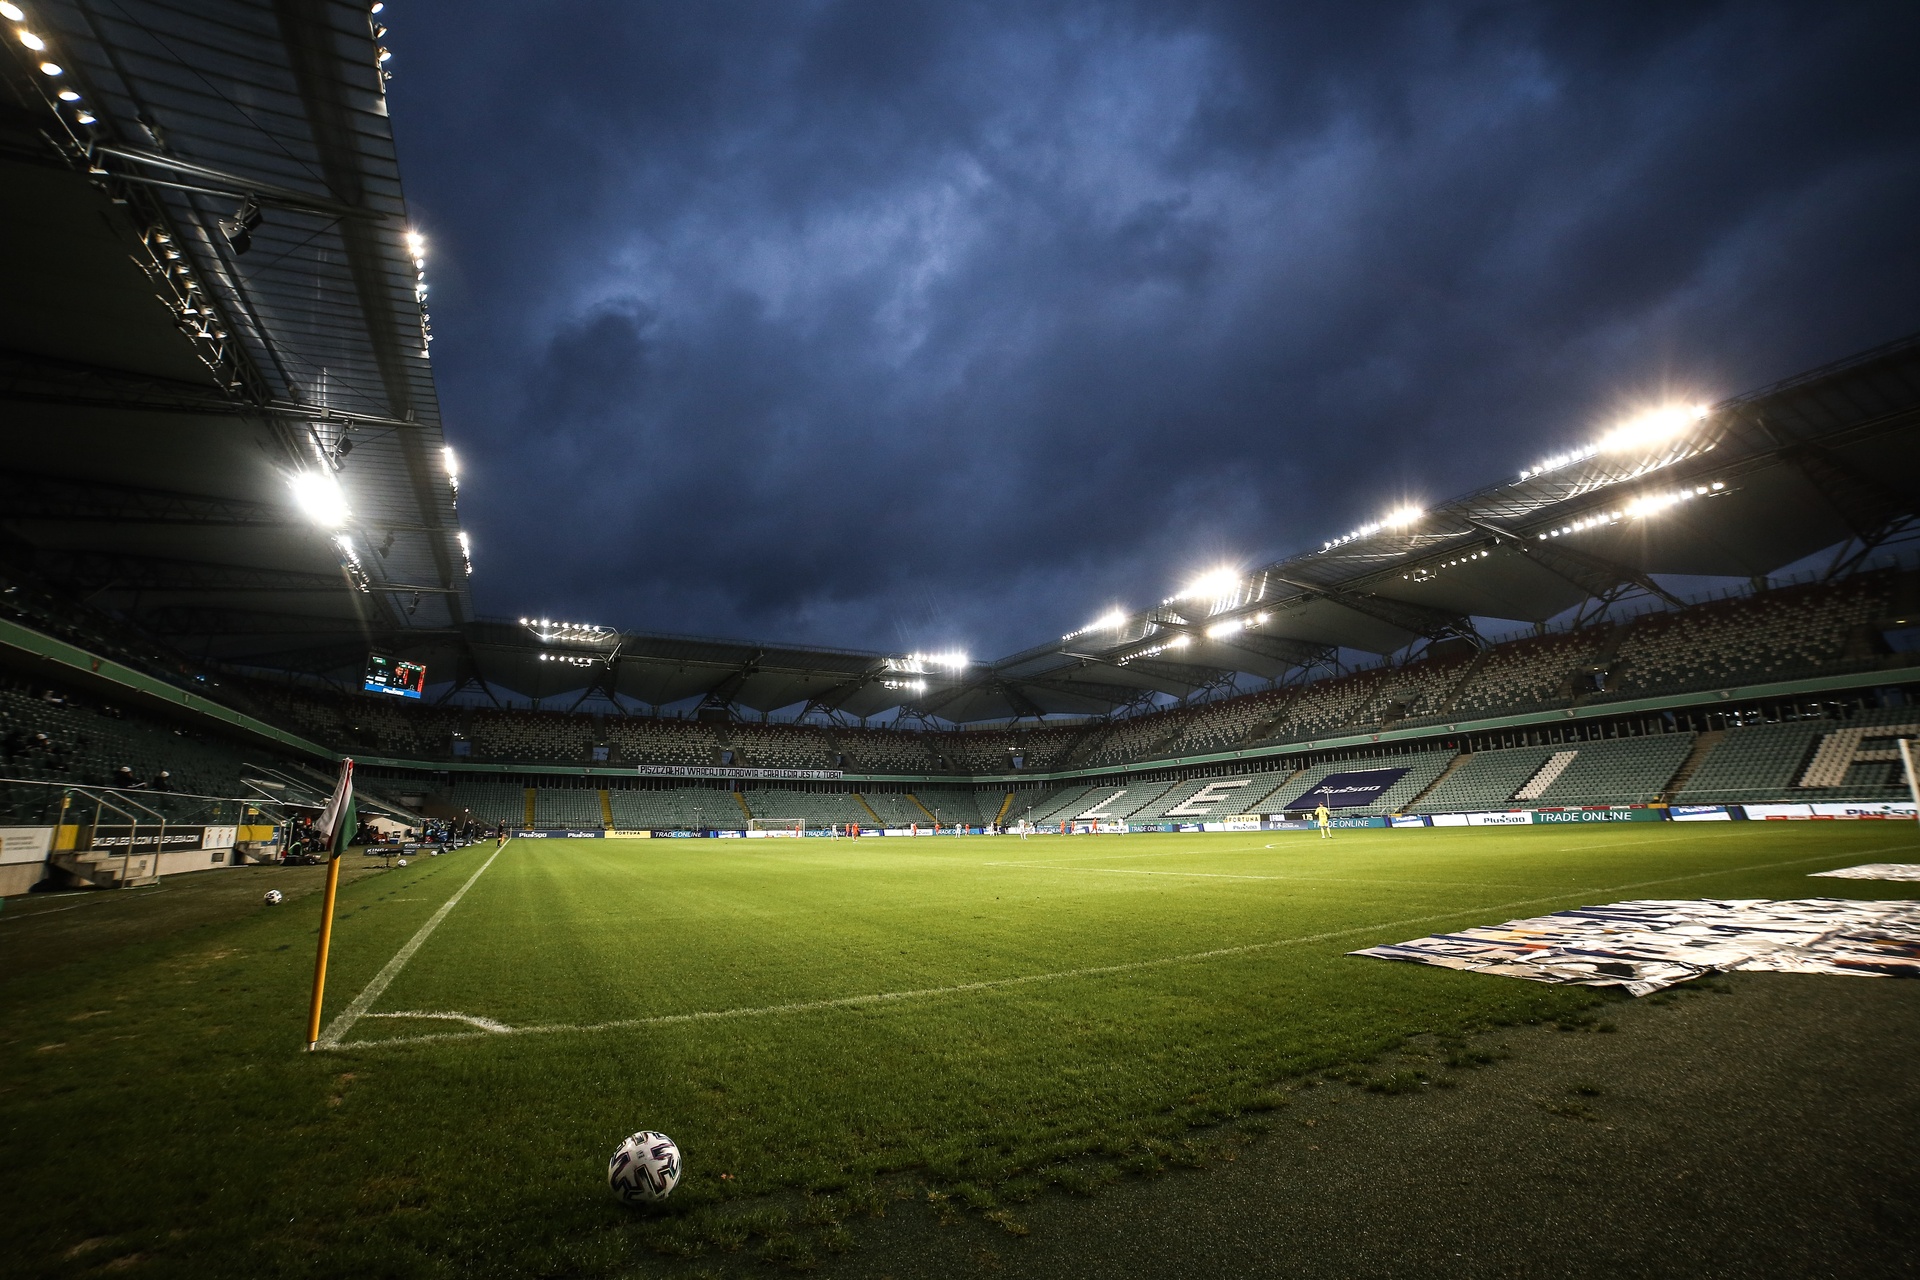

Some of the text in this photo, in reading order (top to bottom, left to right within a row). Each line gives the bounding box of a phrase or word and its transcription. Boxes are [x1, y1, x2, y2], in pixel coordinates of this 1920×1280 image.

[687, 767, 718, 776] WRACAJ
[728, 768, 759, 778] ZDROWIA
[799, 770, 814, 778] JEST
[1484, 815, 1525, 823] Plus500
[1539, 811, 1632, 822] TRADE ONLINE
[1340, 819, 1369, 828] ONLINE
